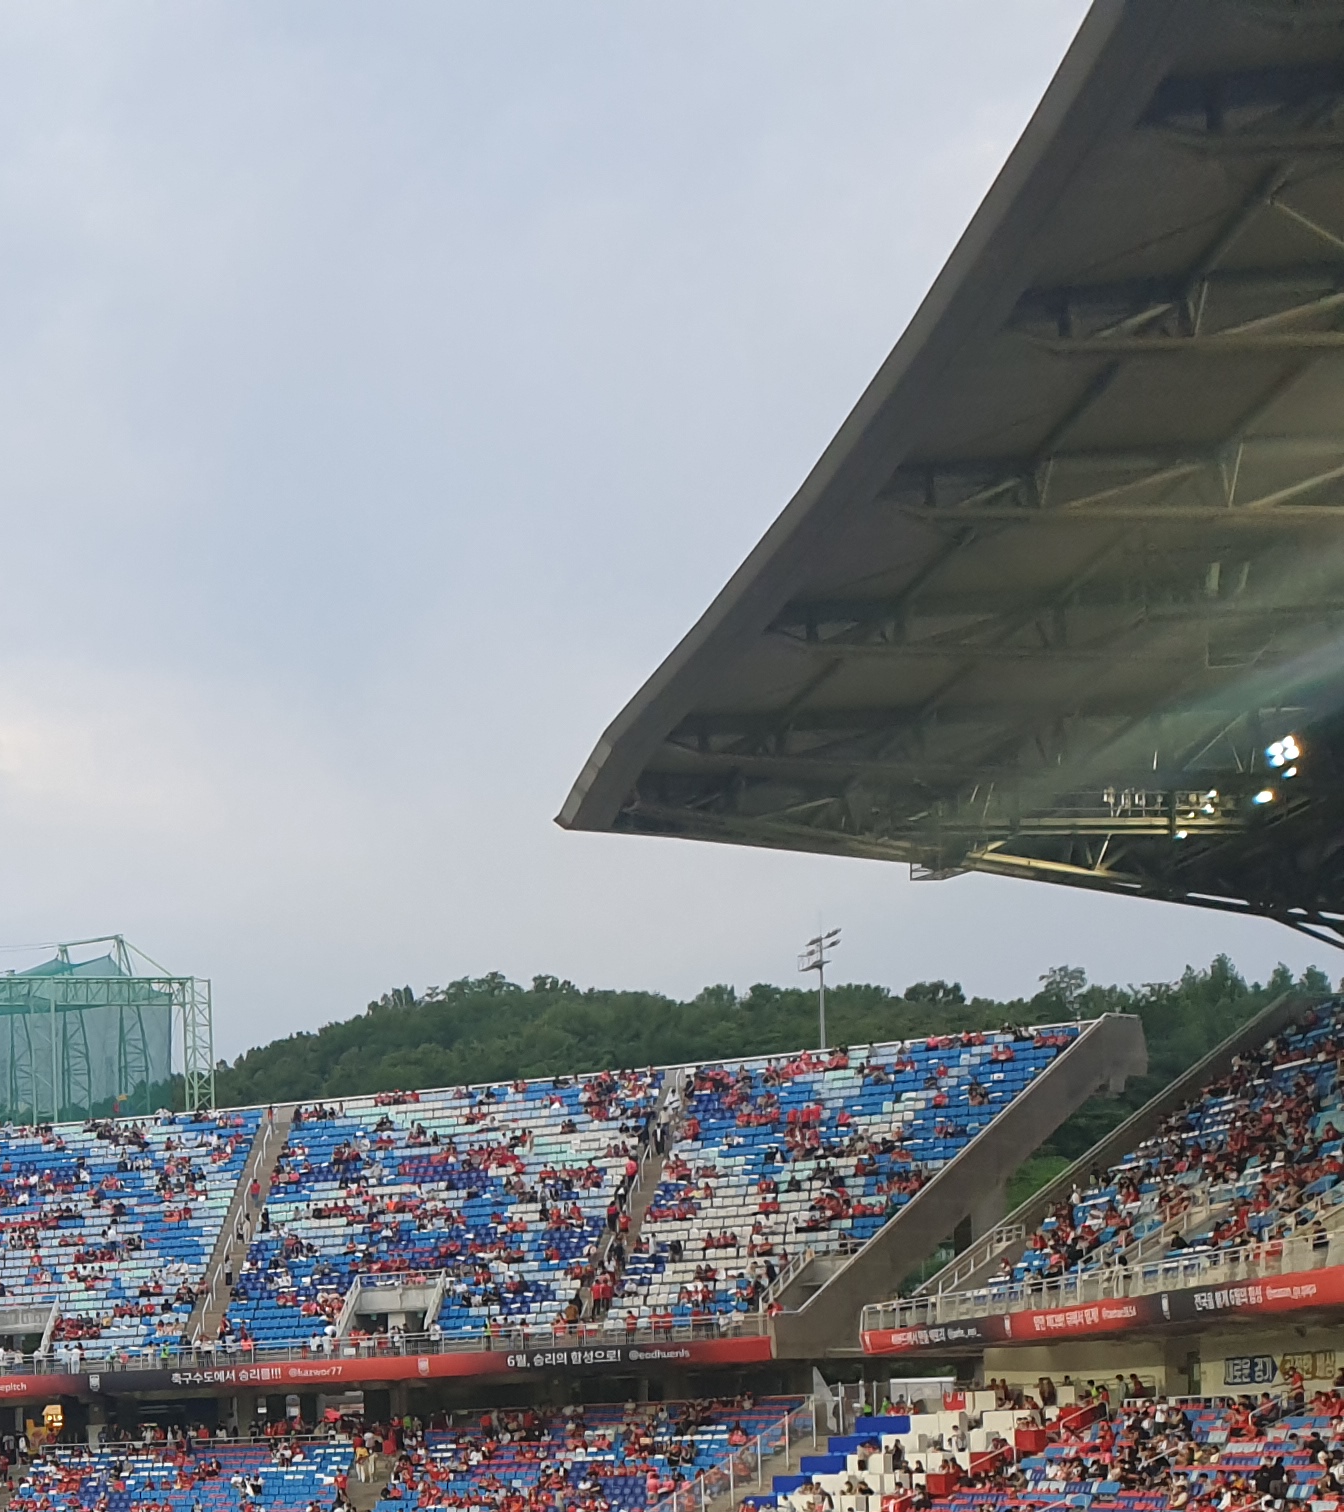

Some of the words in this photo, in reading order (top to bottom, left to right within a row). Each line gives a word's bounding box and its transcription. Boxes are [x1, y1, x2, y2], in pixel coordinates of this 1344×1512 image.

[533, 1352, 567, 1366] 승리의
[571, 1349, 621, 1365] 함성으로!
[171, 1370, 236, 1385] 축구수도에서
[238, 1367, 282, 1382] 승리를!!!
